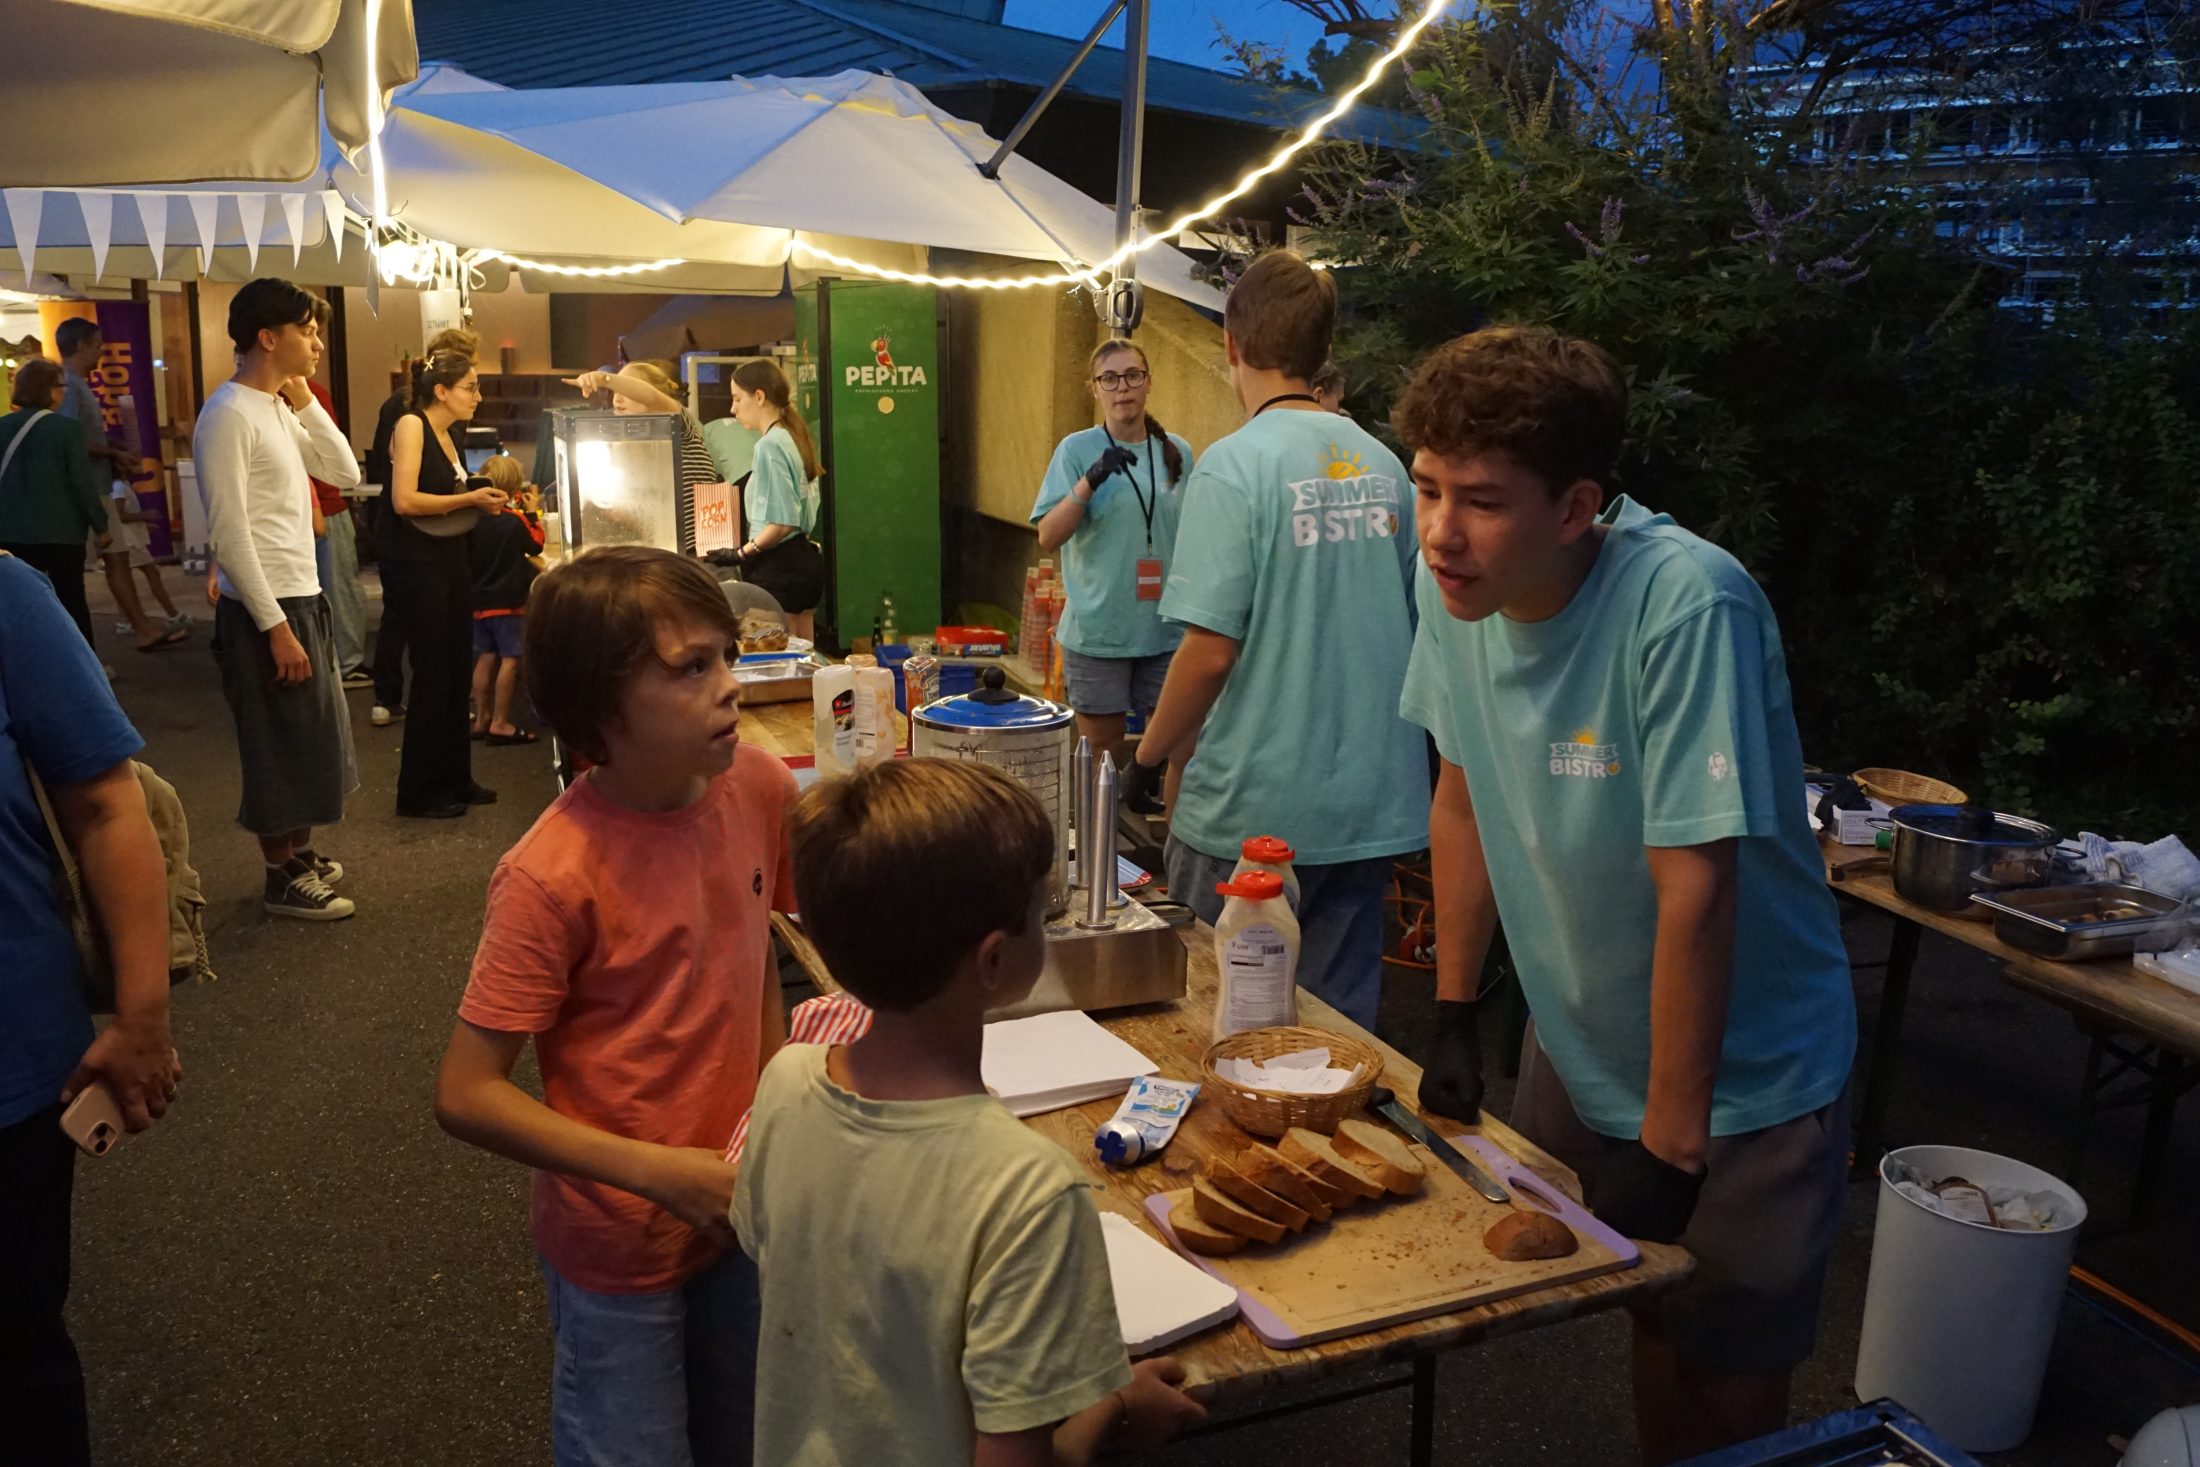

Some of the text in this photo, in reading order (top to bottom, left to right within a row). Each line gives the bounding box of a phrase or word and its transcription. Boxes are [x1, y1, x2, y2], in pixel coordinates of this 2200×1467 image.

[845, 365, 927, 386] PEPITA
[702, 500, 724, 518] POP
[701, 512, 727, 530] CORN
[1555, 743, 1615, 758] SUMMER
